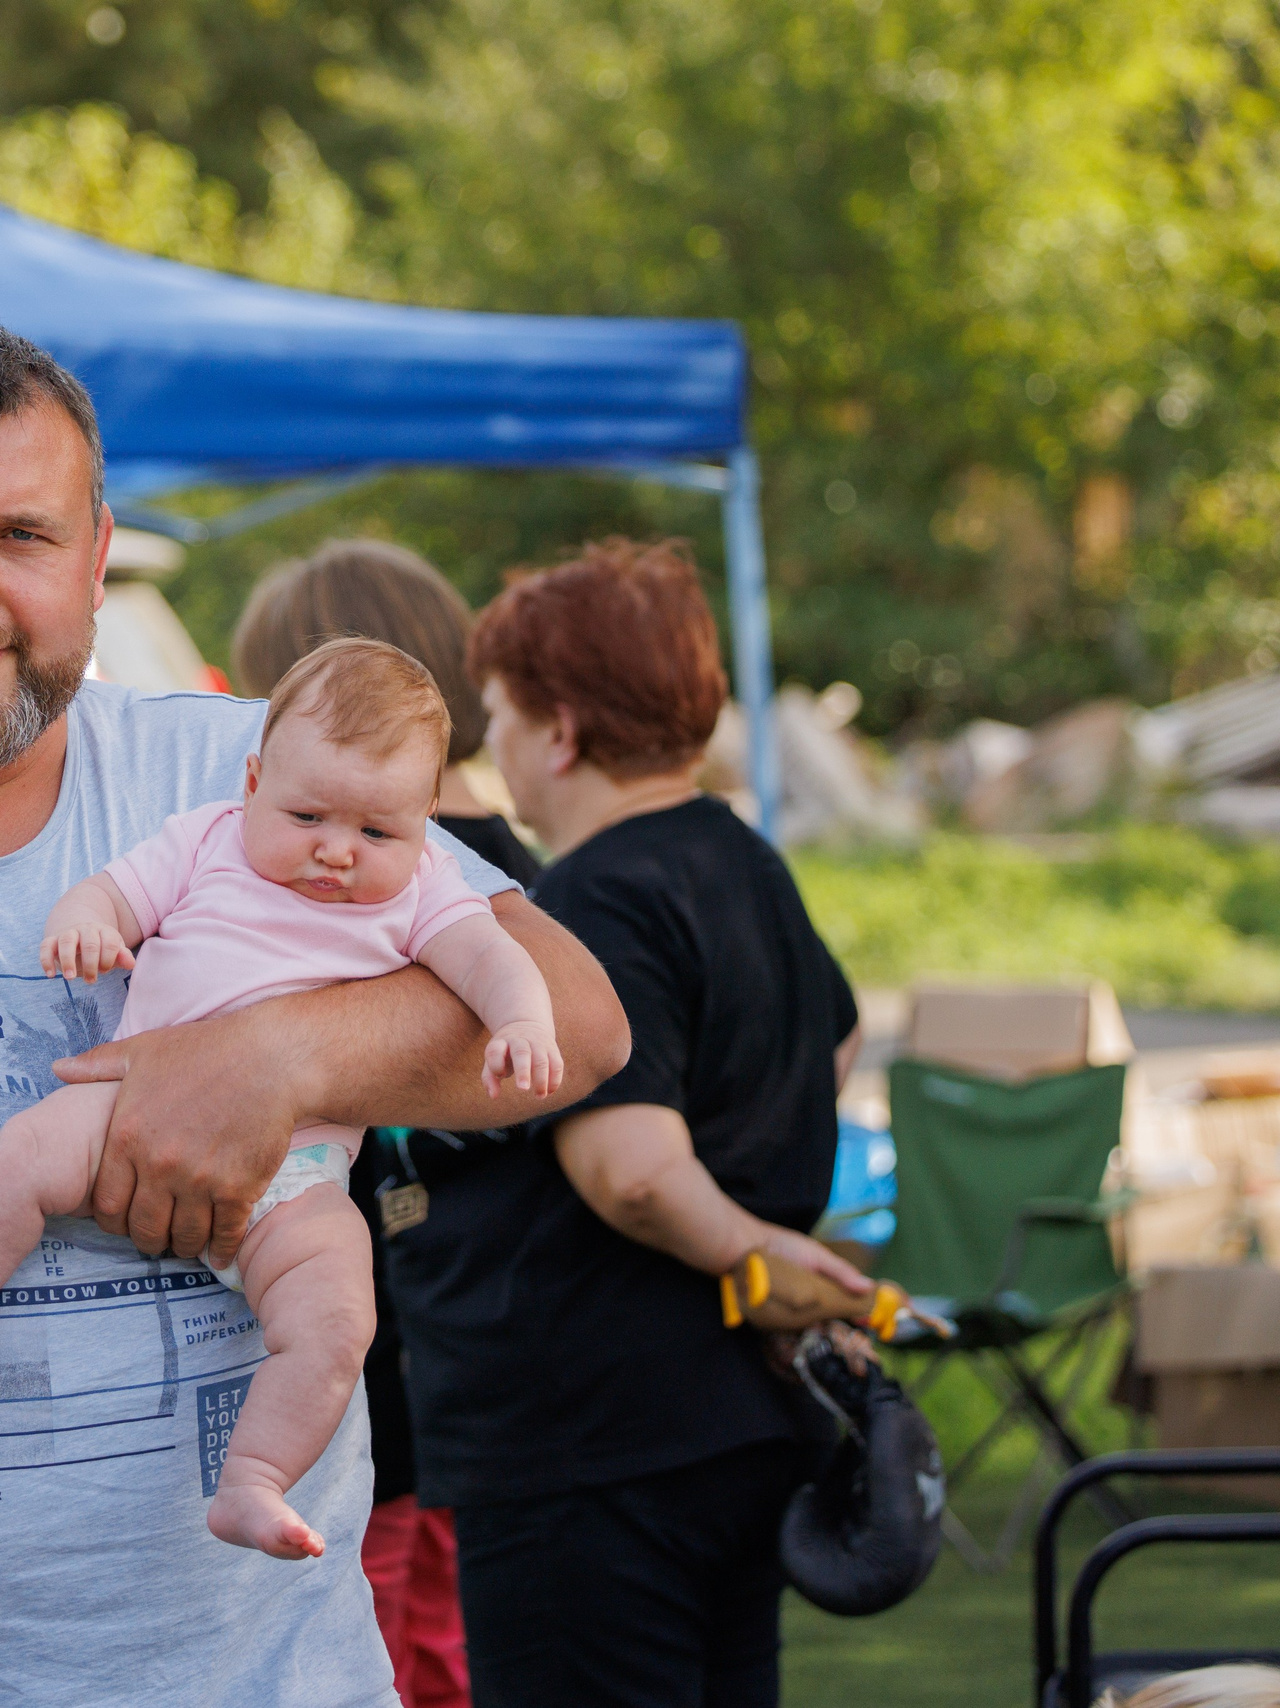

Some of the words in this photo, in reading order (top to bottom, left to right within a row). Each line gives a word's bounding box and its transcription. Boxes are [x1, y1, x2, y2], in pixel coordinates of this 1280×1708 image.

[40, 1240, 75, 1251] FOR
[43, 1253, 58, 1264] LI
[45, 1266, 65, 1277] FE
[1, 1285, 97, 1304] FOLLOW
[111, 1277, 173, 1295] YOUR
[182, 1310, 226, 1329] THINK
[205, 1388, 241, 1412] LET
